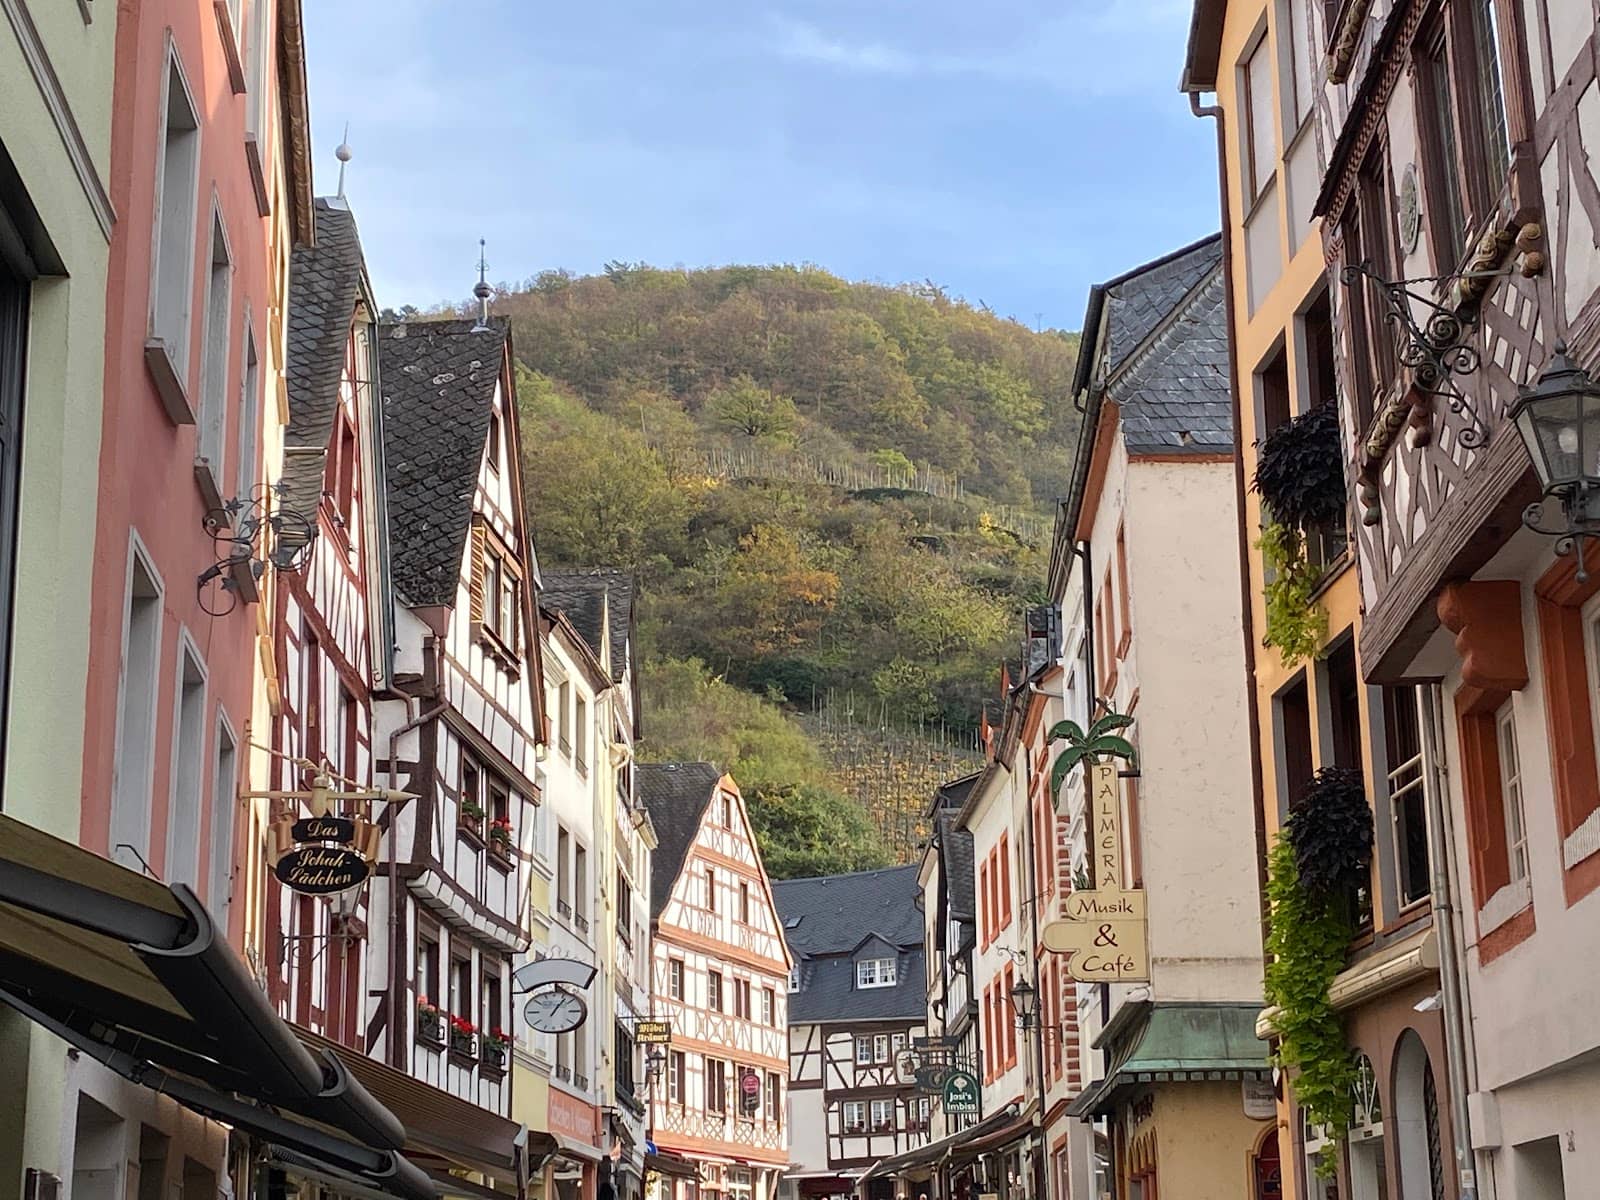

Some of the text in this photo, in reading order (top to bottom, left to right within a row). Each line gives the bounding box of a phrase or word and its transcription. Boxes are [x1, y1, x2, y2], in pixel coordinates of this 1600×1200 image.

[307, 820, 338, 837] Das
[1099, 767, 1117, 887] PALMERA
[287, 867, 352, 885] Lädchen
[1076, 898, 1133, 915] Musik
[1093, 923, 1118, 947] &
[1082, 954, 1136, 978] Café
[946, 1102, 976, 1111] Imbiss
